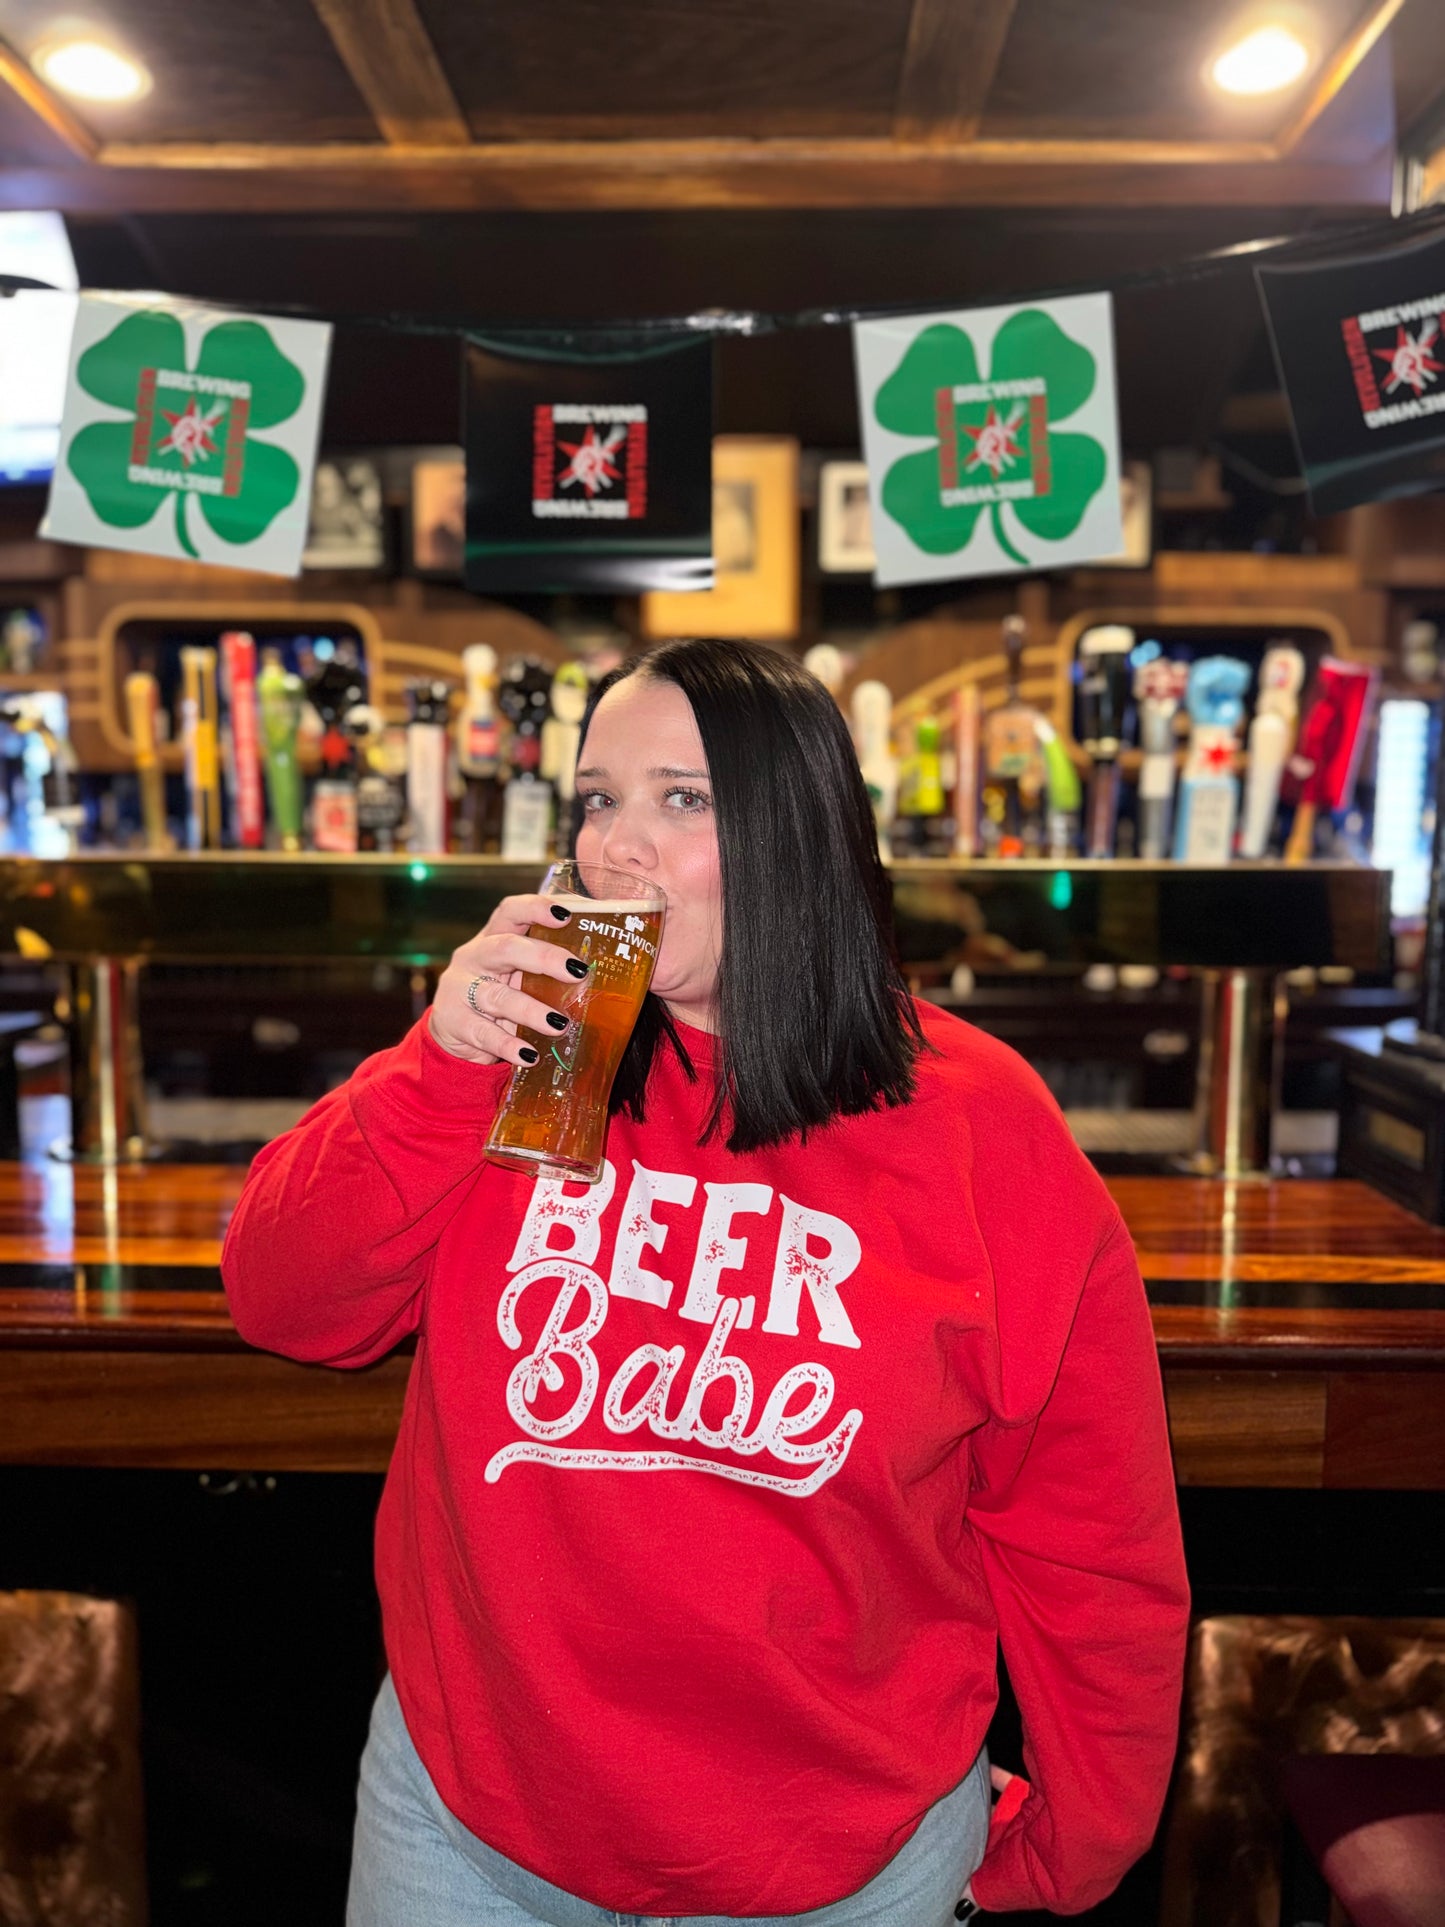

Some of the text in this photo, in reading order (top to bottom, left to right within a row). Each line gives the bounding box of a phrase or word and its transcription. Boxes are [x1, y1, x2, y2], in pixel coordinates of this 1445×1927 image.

[1358, 293, 1445, 333] BREWIN
[156, 367, 252, 400] BREWING
[953, 376, 1047, 405] BREWING
[553, 404, 648, 423] BREWING
[505, 1158, 862, 1349] BEER
[497, 1258, 863, 1466] Babe
